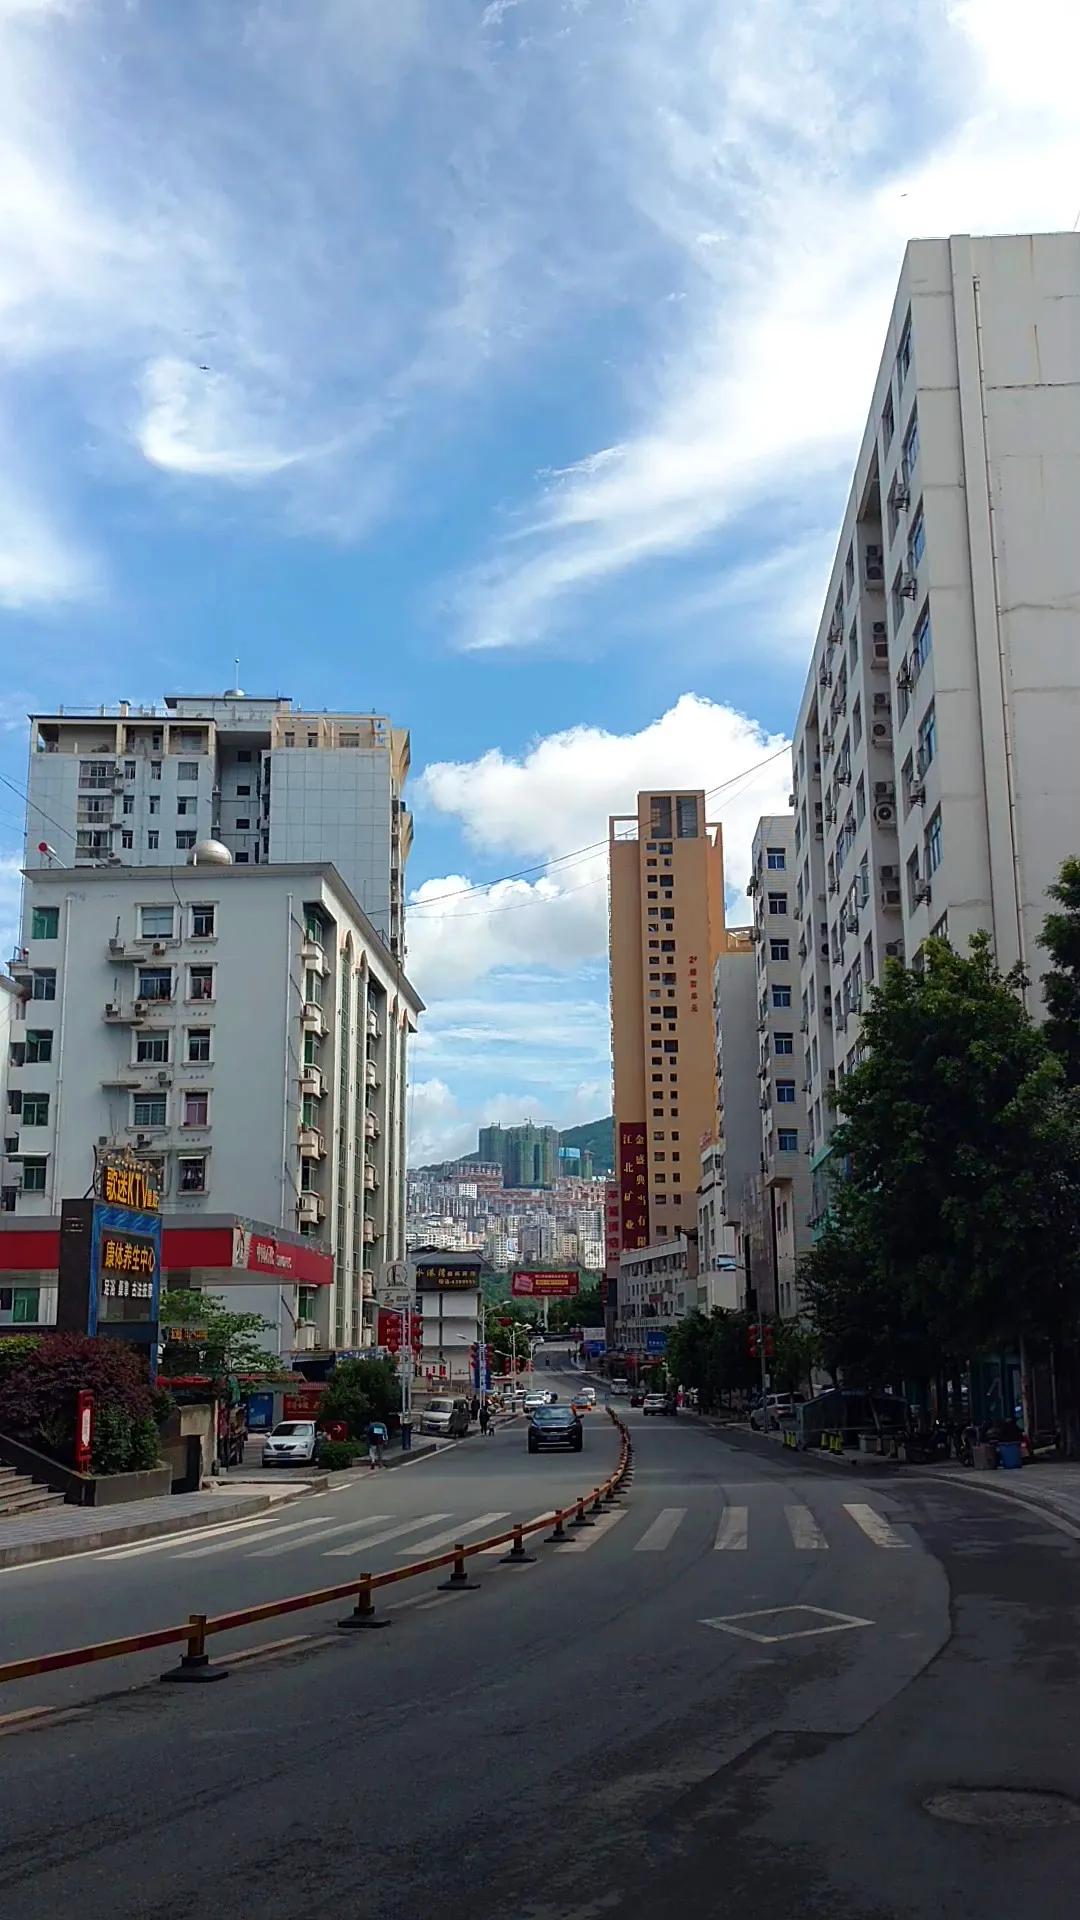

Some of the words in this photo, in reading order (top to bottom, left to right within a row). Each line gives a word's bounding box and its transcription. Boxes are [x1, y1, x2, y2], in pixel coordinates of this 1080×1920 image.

[105, 1240, 156, 1272] 康体养生中心
